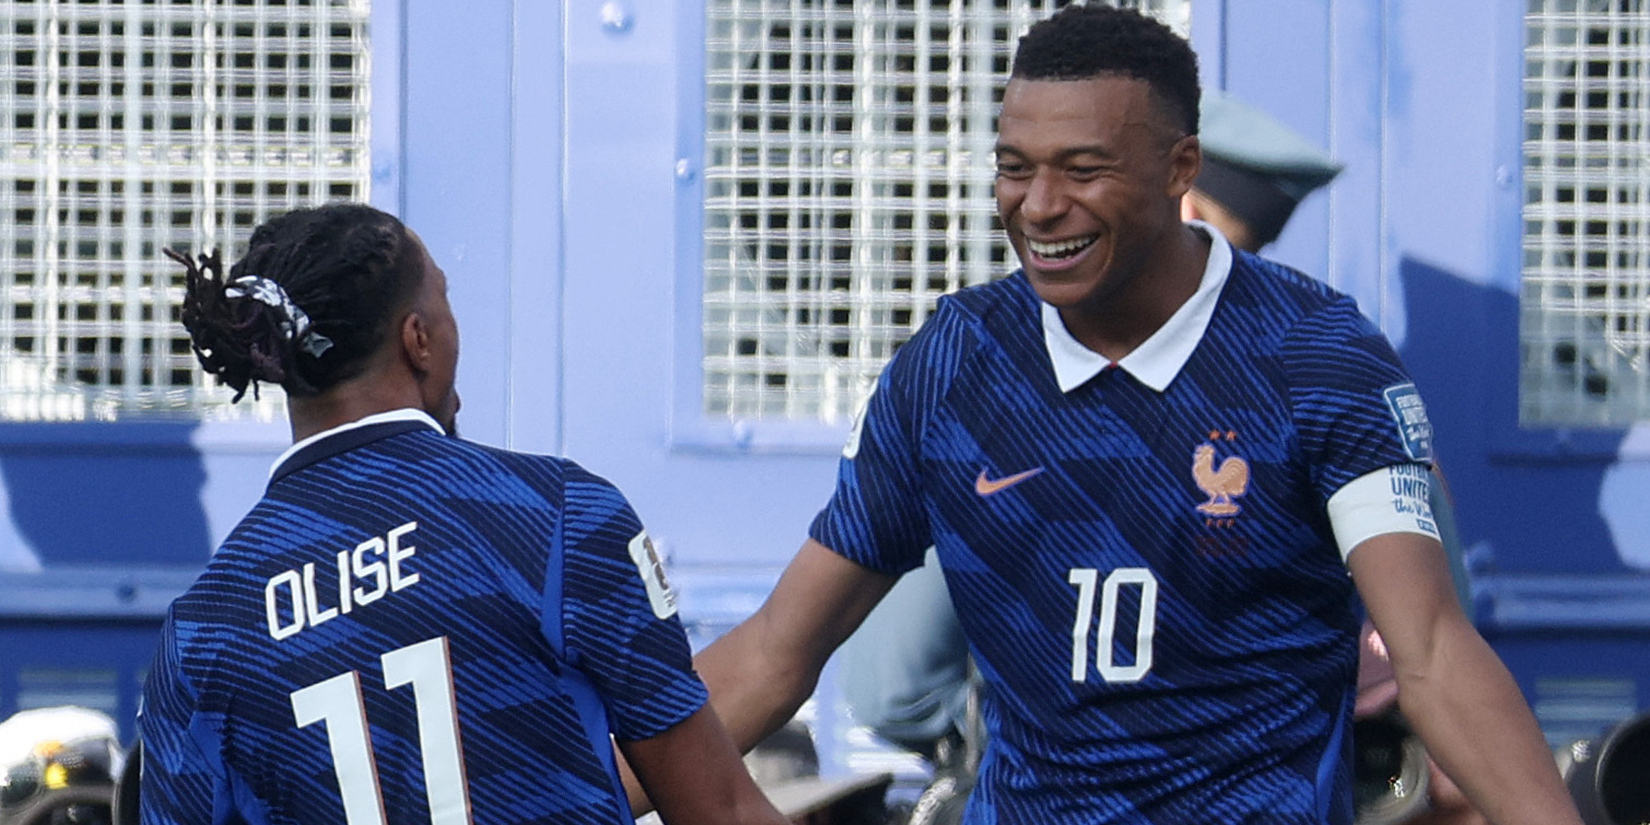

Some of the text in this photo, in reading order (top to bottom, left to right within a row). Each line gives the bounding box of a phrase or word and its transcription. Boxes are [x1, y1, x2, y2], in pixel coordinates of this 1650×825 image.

[265, 521, 420, 641] OLISE
[1069, 568, 1158, 682] 10
[290, 636, 473, 825] 11
